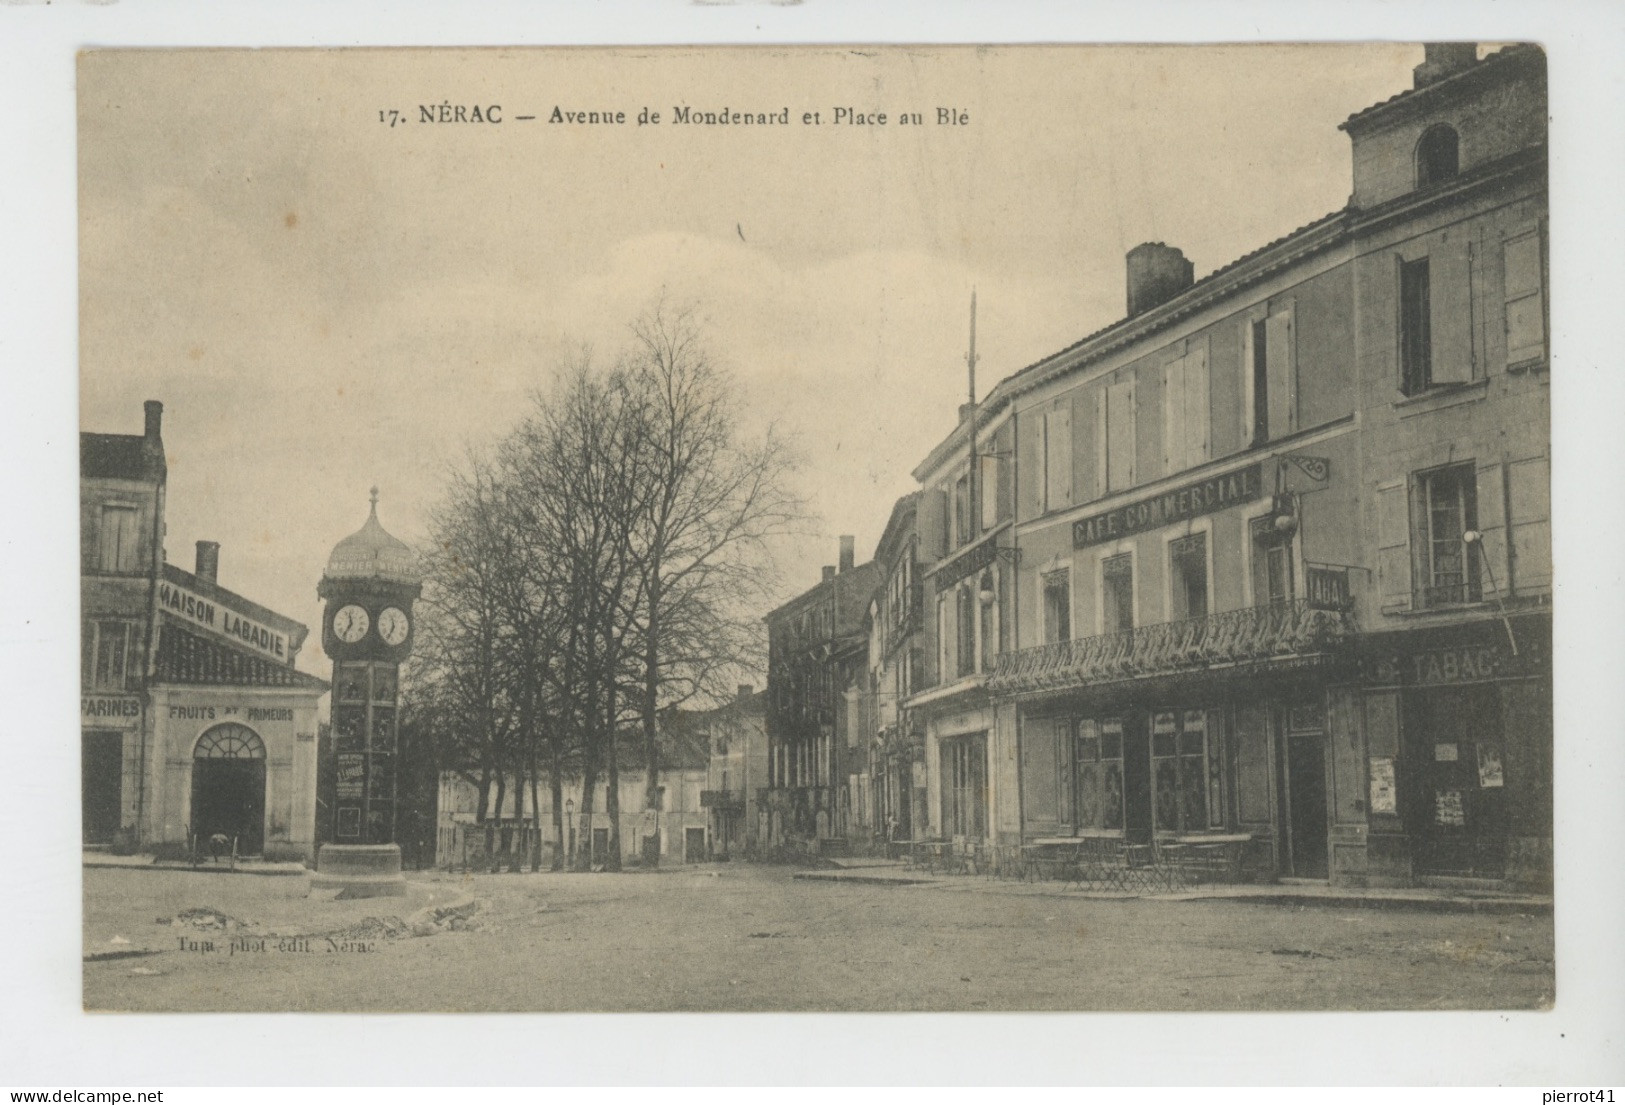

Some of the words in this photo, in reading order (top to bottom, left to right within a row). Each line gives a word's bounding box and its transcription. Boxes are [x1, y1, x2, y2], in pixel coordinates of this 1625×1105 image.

[378, 110, 407, 128] 17.
[419, 101, 502, 124] NÉRAC
[548, 106, 625, 124] Avenue
[637, 106, 660, 125] de
[672, 106, 789, 125] Mondenard
[833, 107, 887, 125] Place
[899, 112, 923, 125] au
[936, 106, 969, 126] Blé
[1124, 472, 1253, 530] COMMERCIAL
[159, 580, 214, 625] MAISON
[223, 610, 285, 658] LABADIE
[1413, 649, 1493, 682] TABAC
[169, 706, 215, 721] FRUITS
[247, 706, 294, 722] PRIMEURS
